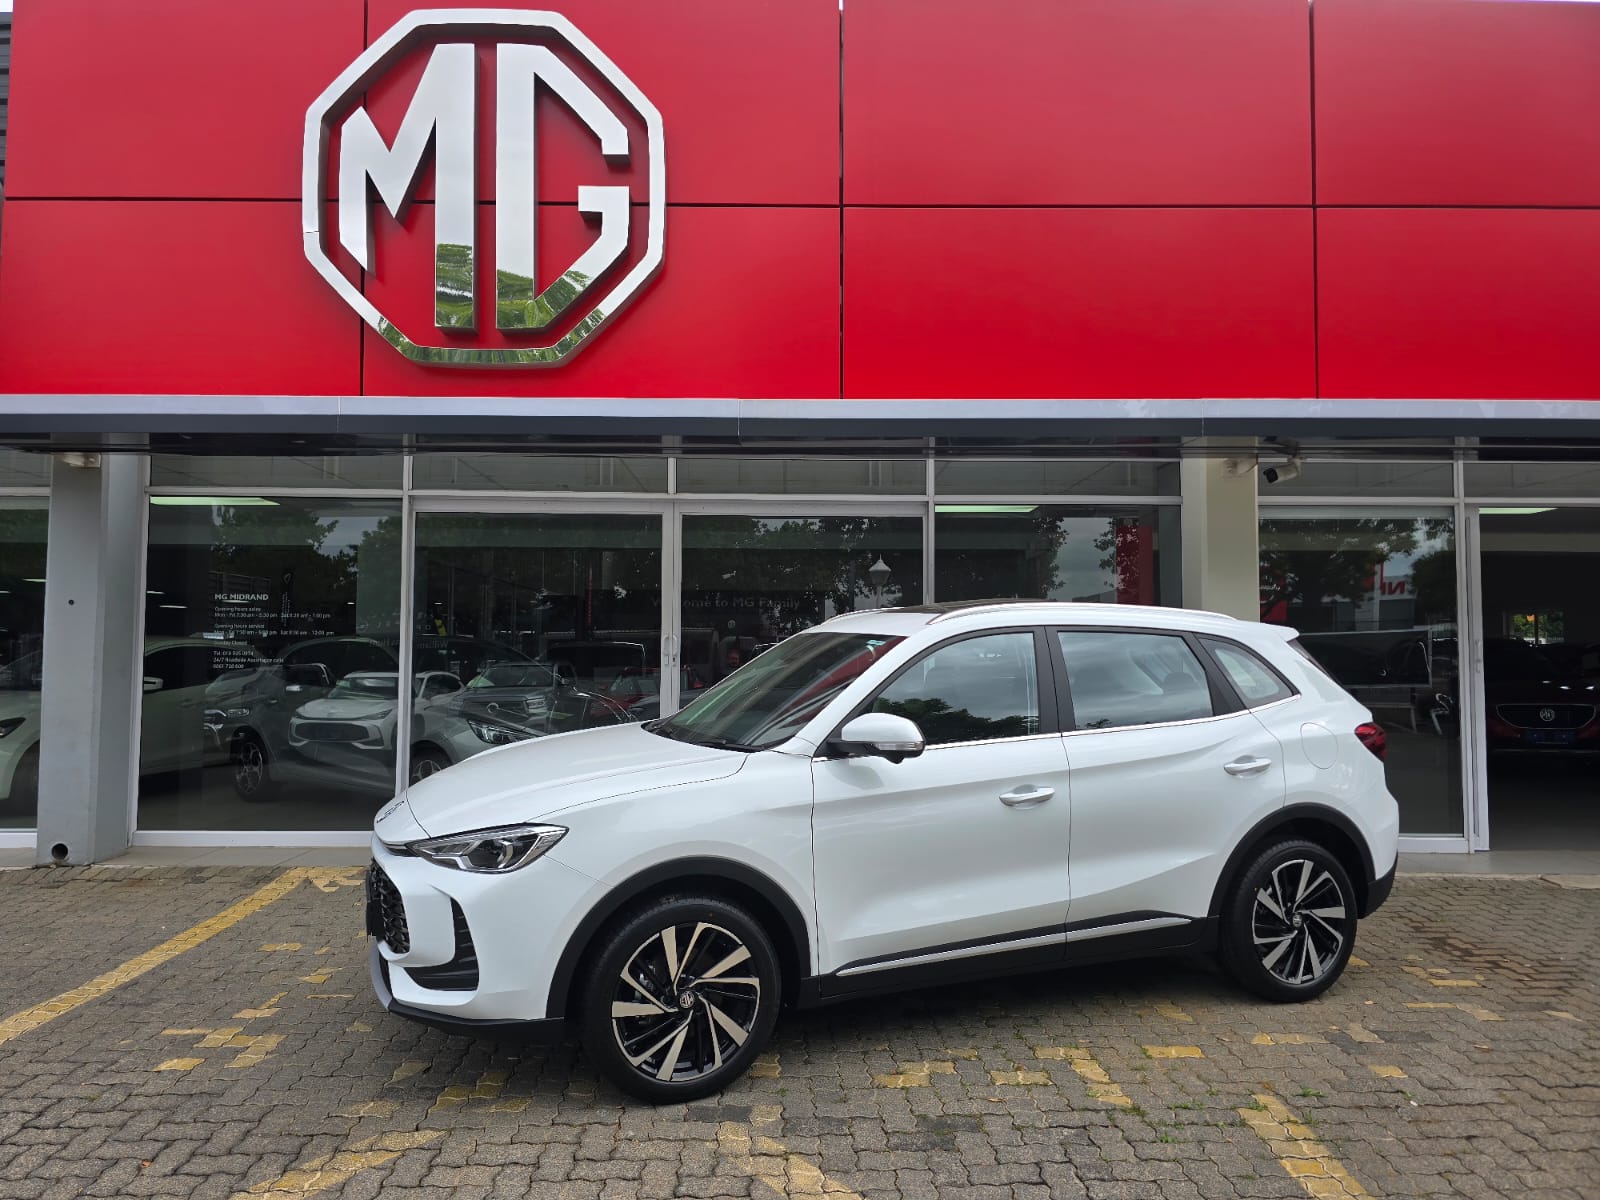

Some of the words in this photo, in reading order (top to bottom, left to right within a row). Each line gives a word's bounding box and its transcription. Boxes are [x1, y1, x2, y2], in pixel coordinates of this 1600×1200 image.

[338, 42, 630, 330] MG
[214, 593, 228, 601] MG
[229, 593, 269, 601] MIDRAND
